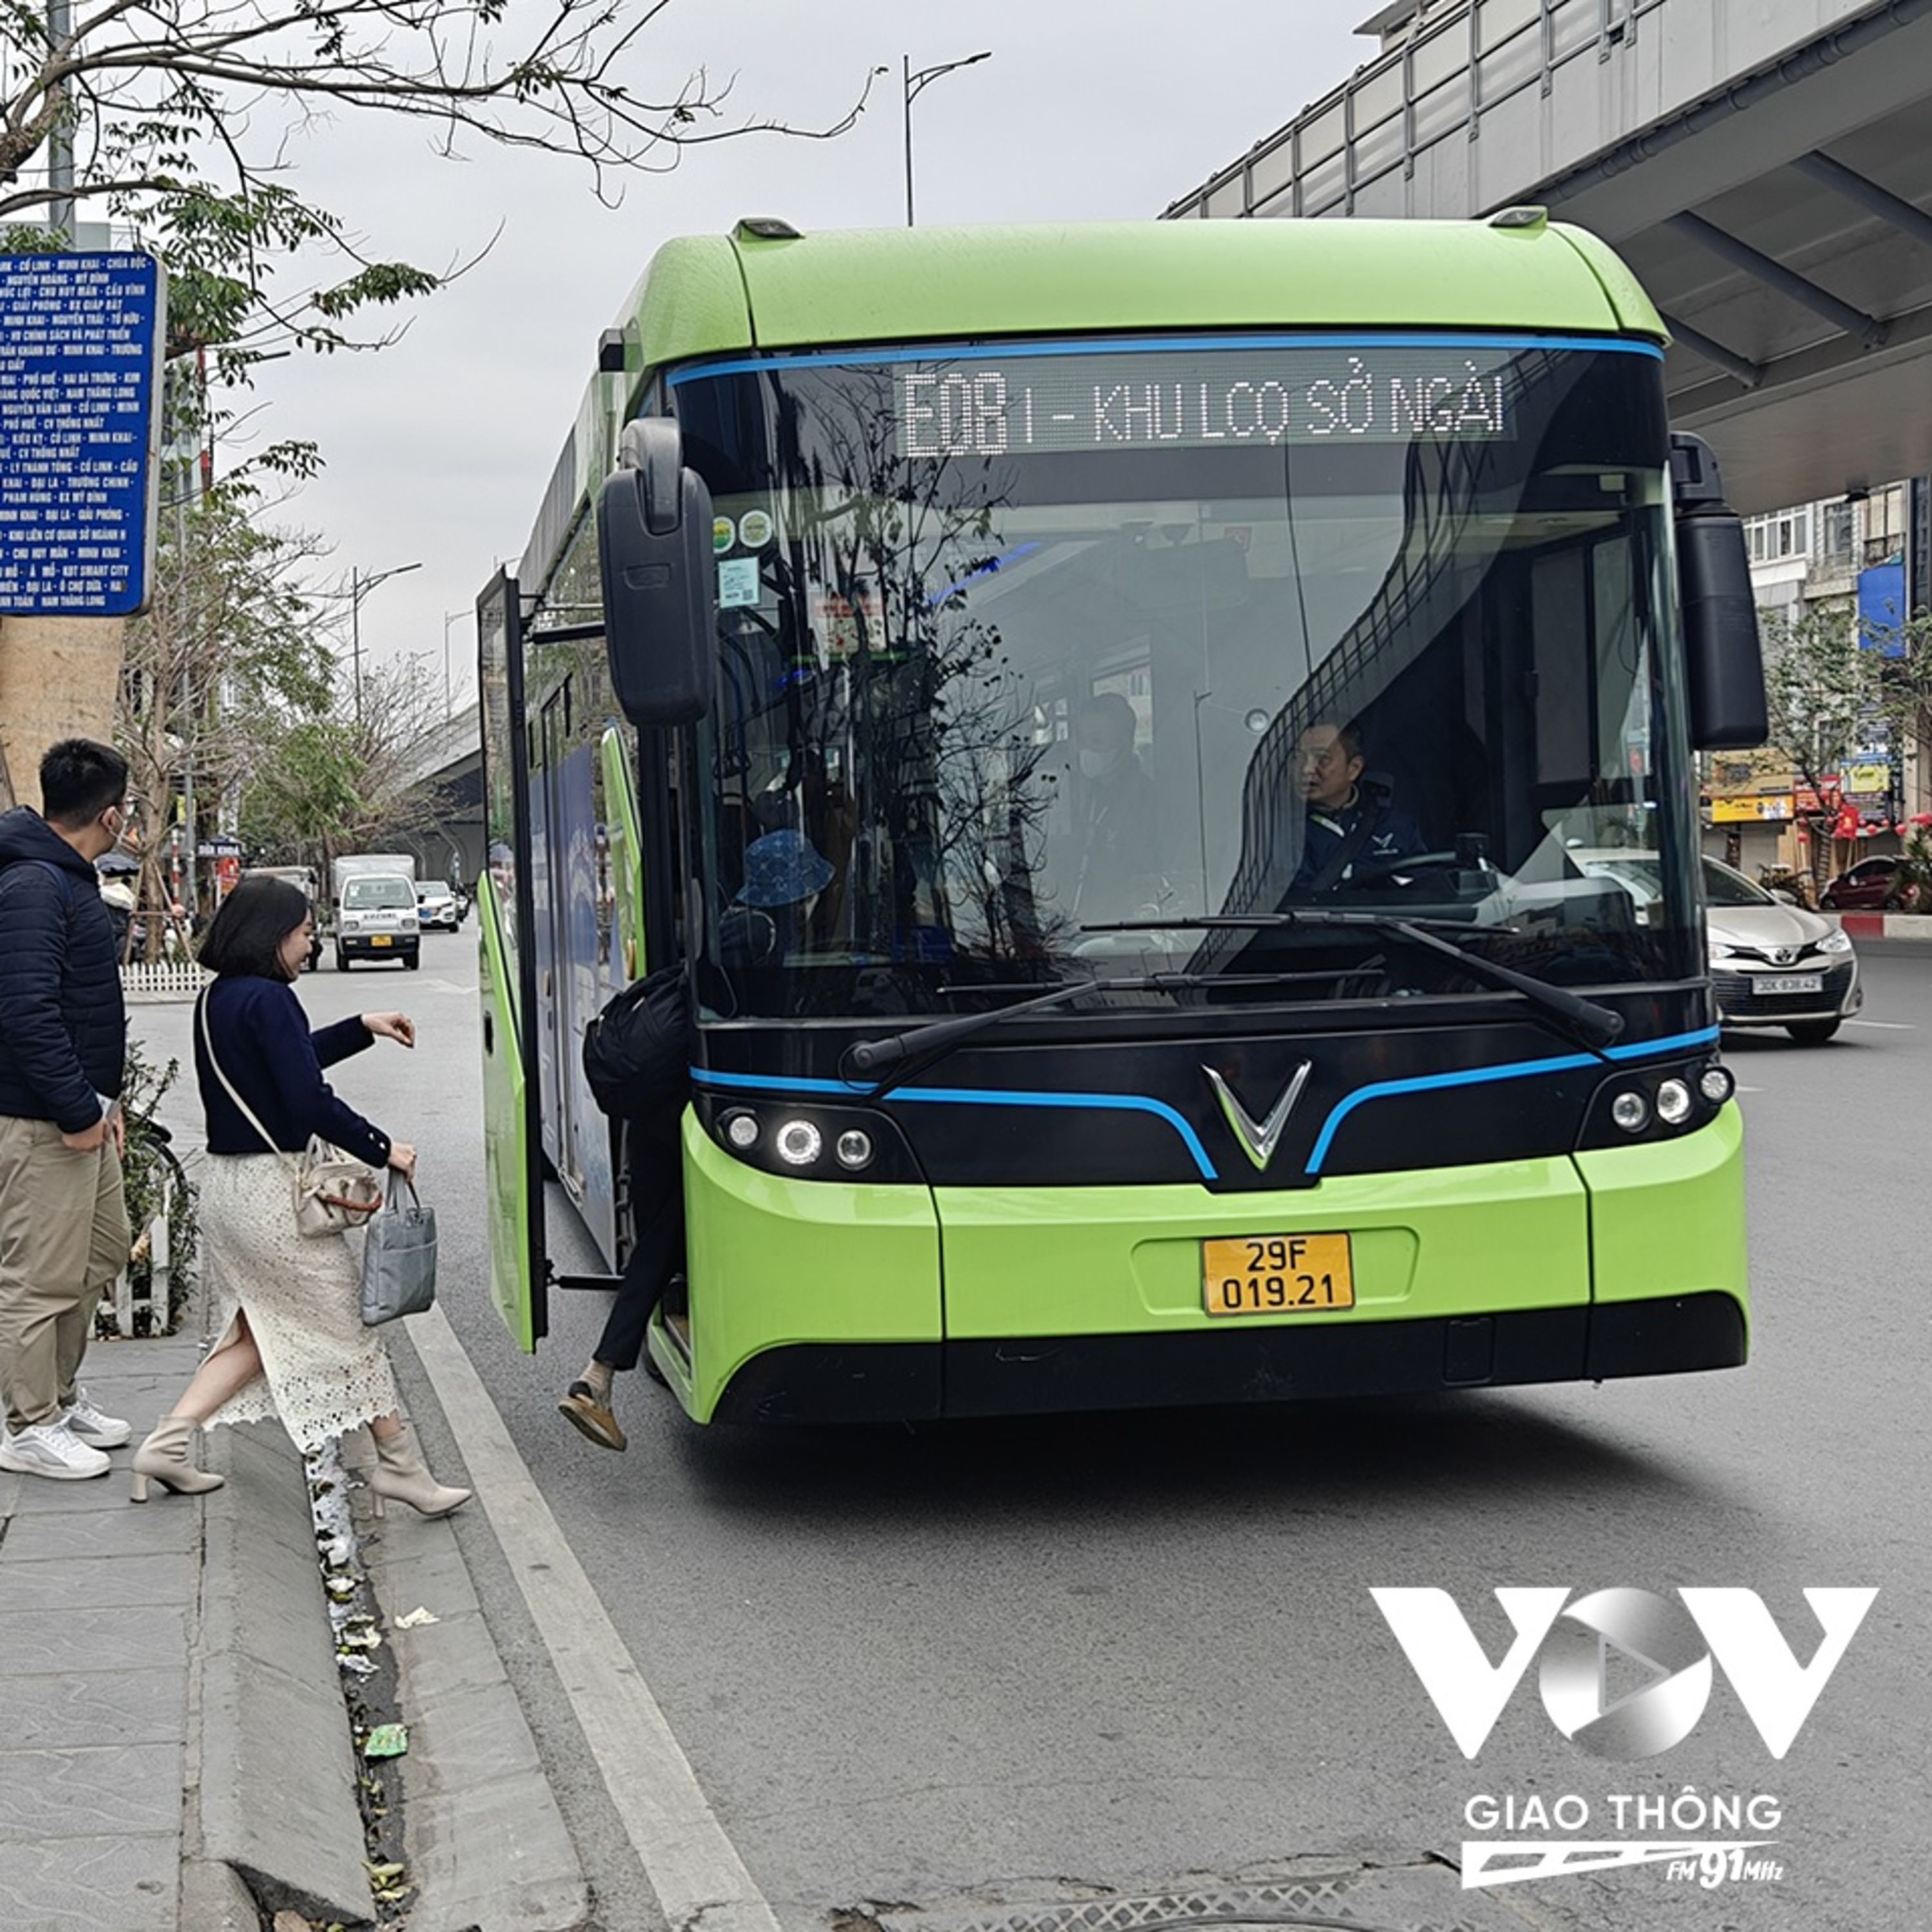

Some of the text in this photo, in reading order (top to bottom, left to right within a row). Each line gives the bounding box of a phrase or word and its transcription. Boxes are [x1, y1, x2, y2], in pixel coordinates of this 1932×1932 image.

[32, 260, 50, 271] LINH
[1094, 384, 1182, 440] KHU
[1307, 357, 1373, 434] SỞ
[80, 565, 108, 576] SMART
[111, 565, 129, 576] CITY
[1247, 1240, 1307, 1271] 29F
[1223, 1274, 1333, 1309] 019.21
